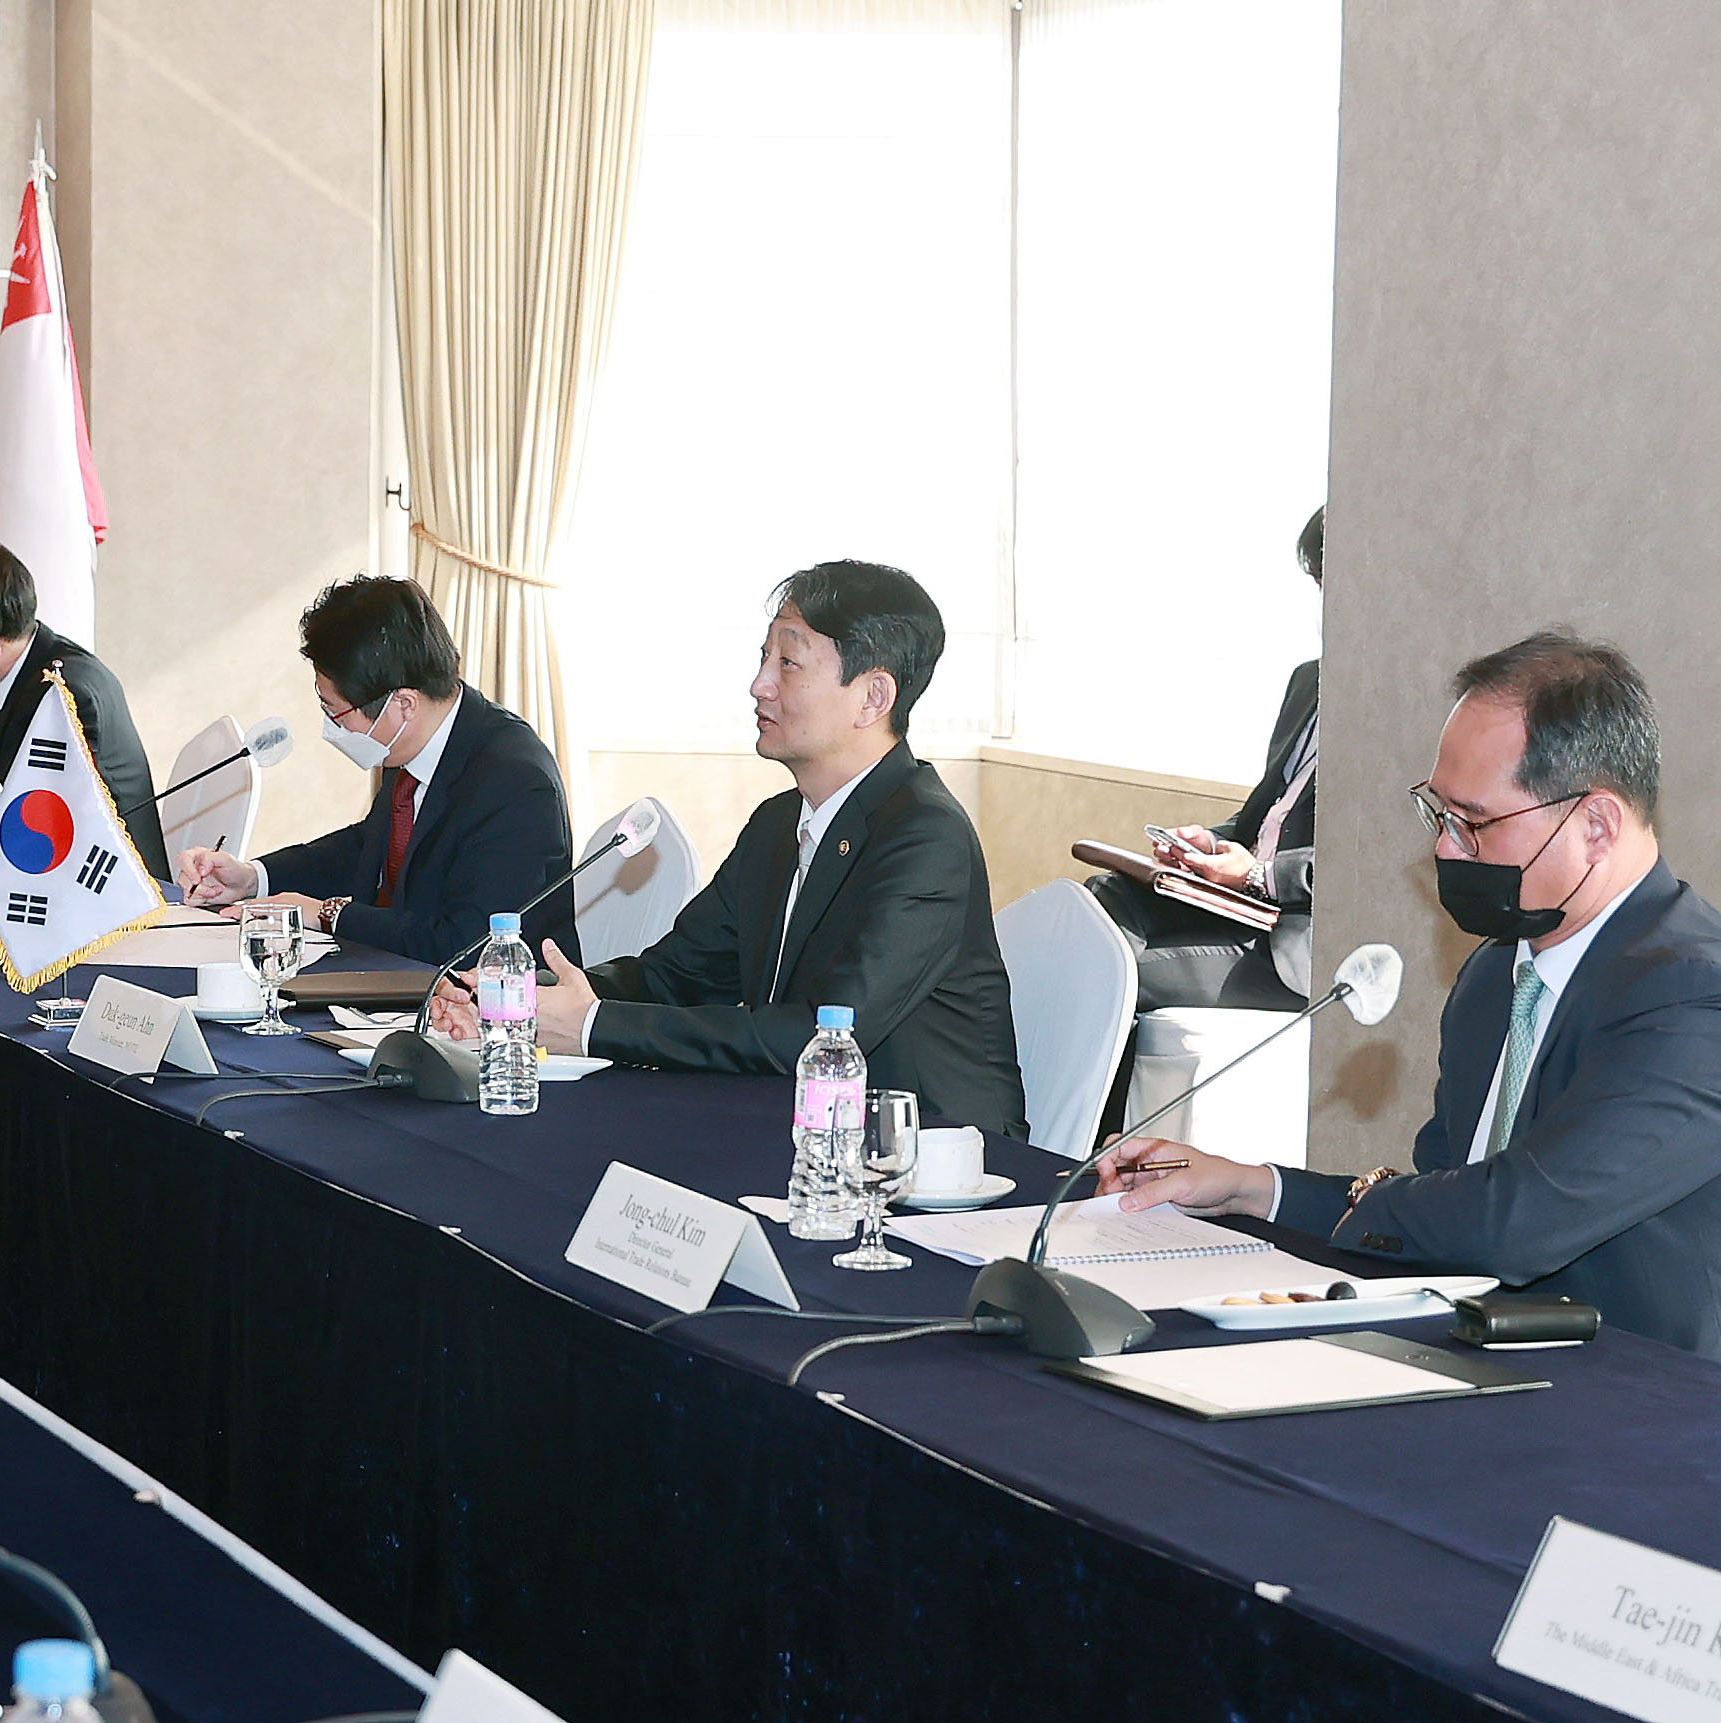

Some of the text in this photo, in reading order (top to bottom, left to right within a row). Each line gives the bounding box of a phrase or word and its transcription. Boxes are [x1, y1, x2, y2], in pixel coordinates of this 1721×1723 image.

[618, 1194, 707, 1248] Jong-chul Kim
[1610, 1584, 1703, 1648] Tae-jin
